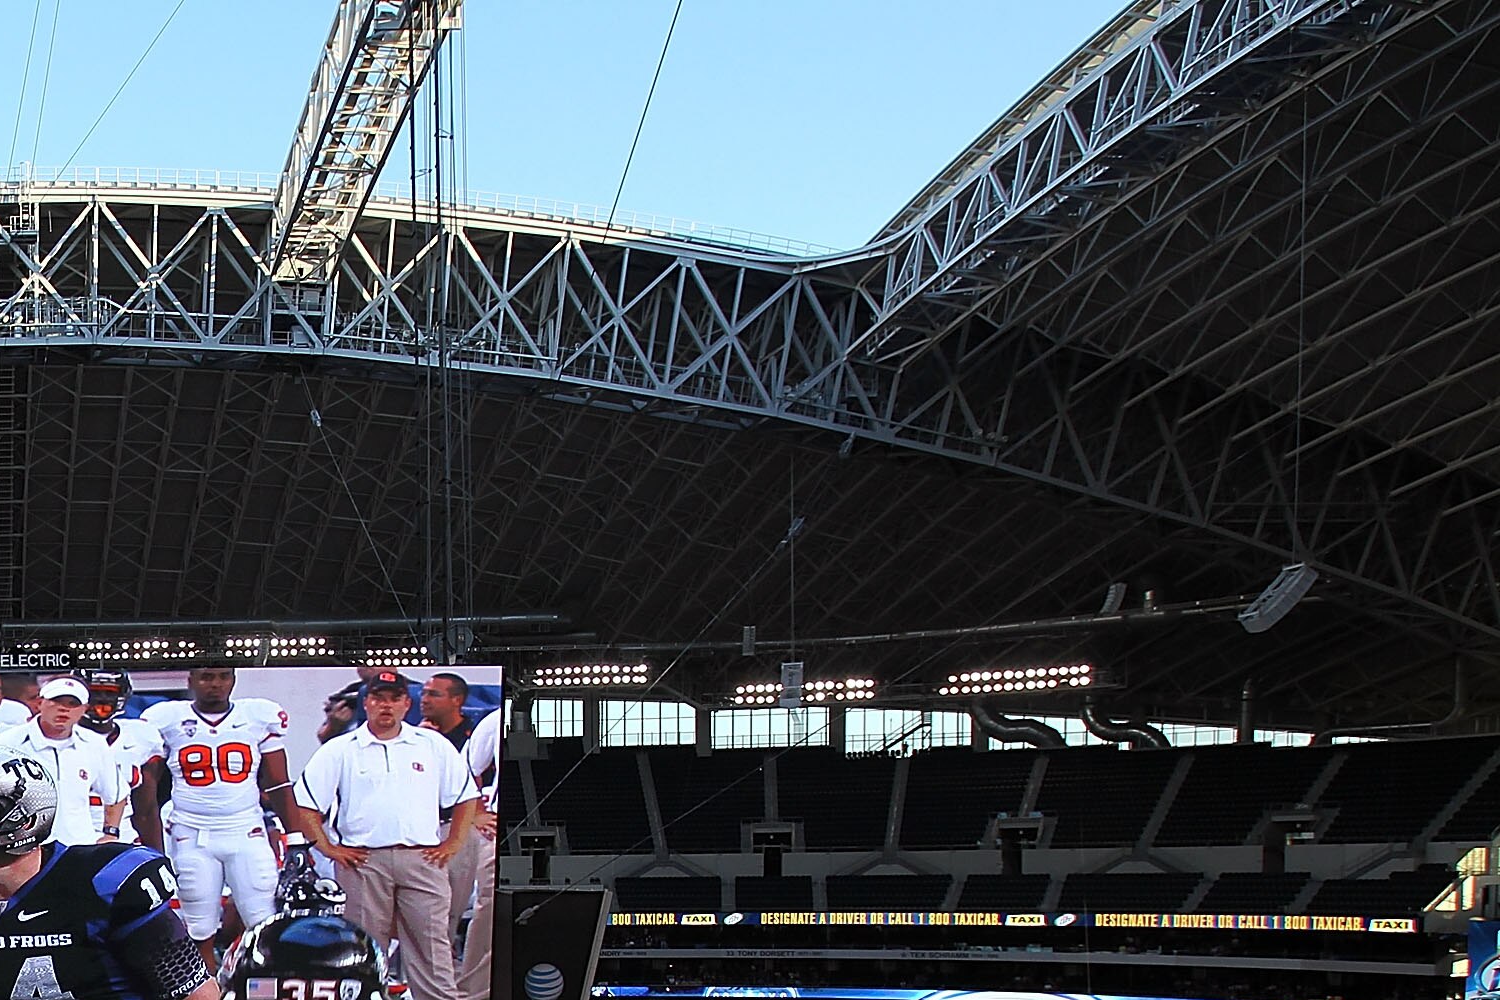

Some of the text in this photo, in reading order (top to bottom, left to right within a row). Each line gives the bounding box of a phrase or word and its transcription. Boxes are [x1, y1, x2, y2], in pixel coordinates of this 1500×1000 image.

[0, 653, 70, 668] ELECTRIC
[178, 742, 253, 787] 80
[14, 836, 37, 848] ADAMS
[612, 913, 678, 925] 800 TAXICAB.
[760, 912, 1002, 925] DESIGNATE A DRIVER OR CALL 1 800 TAXICAB.
[1095, 914, 1367, 931] DESIGNATE A DRIVER OR CALL 1 800 TAXICAB.
[10, 934, 72, 949] FROGS
[171, 980, 194, 997] PRO
